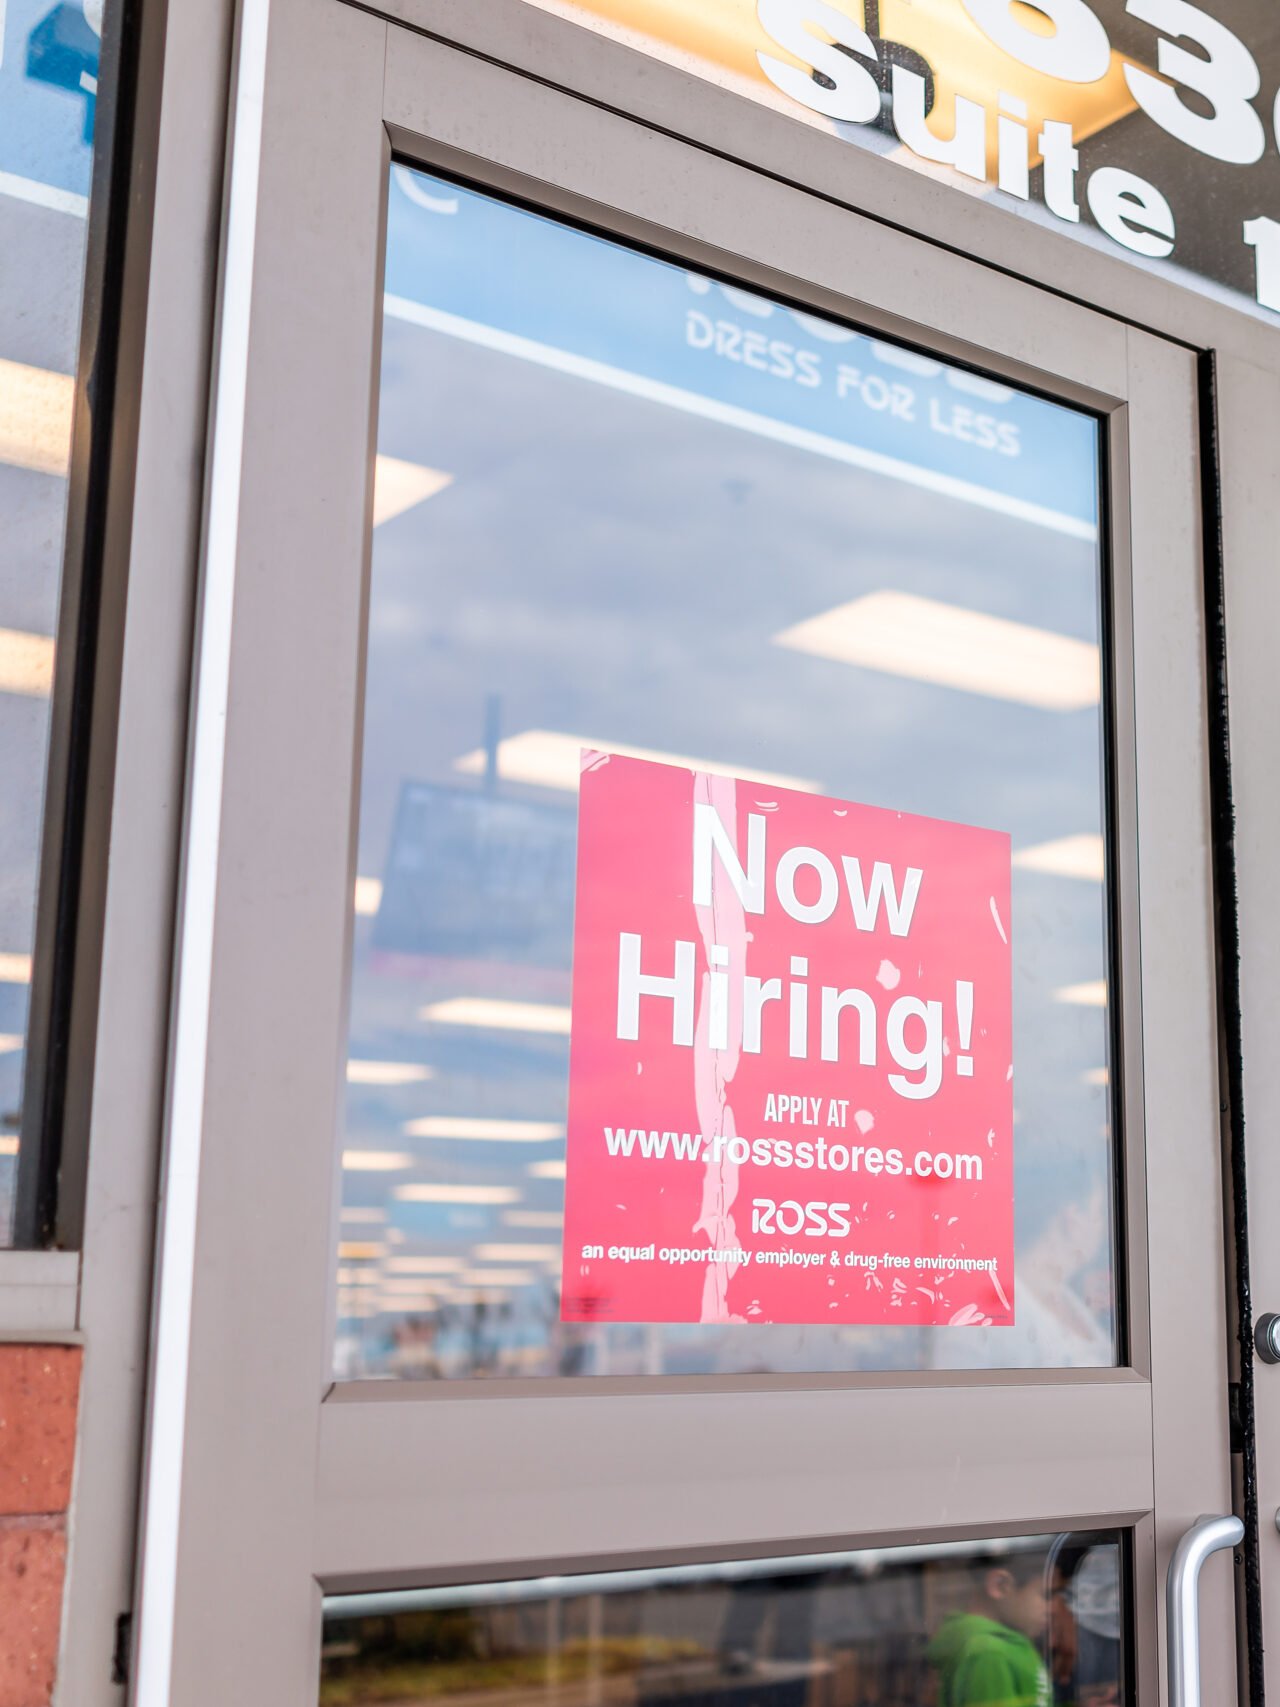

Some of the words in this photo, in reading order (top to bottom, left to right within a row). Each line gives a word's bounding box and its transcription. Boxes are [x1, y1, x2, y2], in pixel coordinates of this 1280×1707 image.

[755, 0, 1176, 258] Suite
[686, 309, 822, 389] DRESS
[836, 364, 917, 422] FOR
[929, 399, 1022, 458] LESS
[692, 802, 923, 937] Now
[616, 932, 975, 1099] Hiring!
[603, 1127, 984, 1181] www.rossstores.com
[764, 1093, 822, 1126] APPLY
[826, 1099, 850, 1128] AT
[581, 1244, 604, 1259] an
[607, 1244, 655, 1263] equal
[658, 1247, 752, 1266] opportunity
[755, 1249, 827, 1268] employer
[829, 1250, 841, 1267] &
[844, 1251, 911, 1270] drug-free
[913, 1254, 999, 1271] environment
[751, 1198, 852, 1237] ROSS
